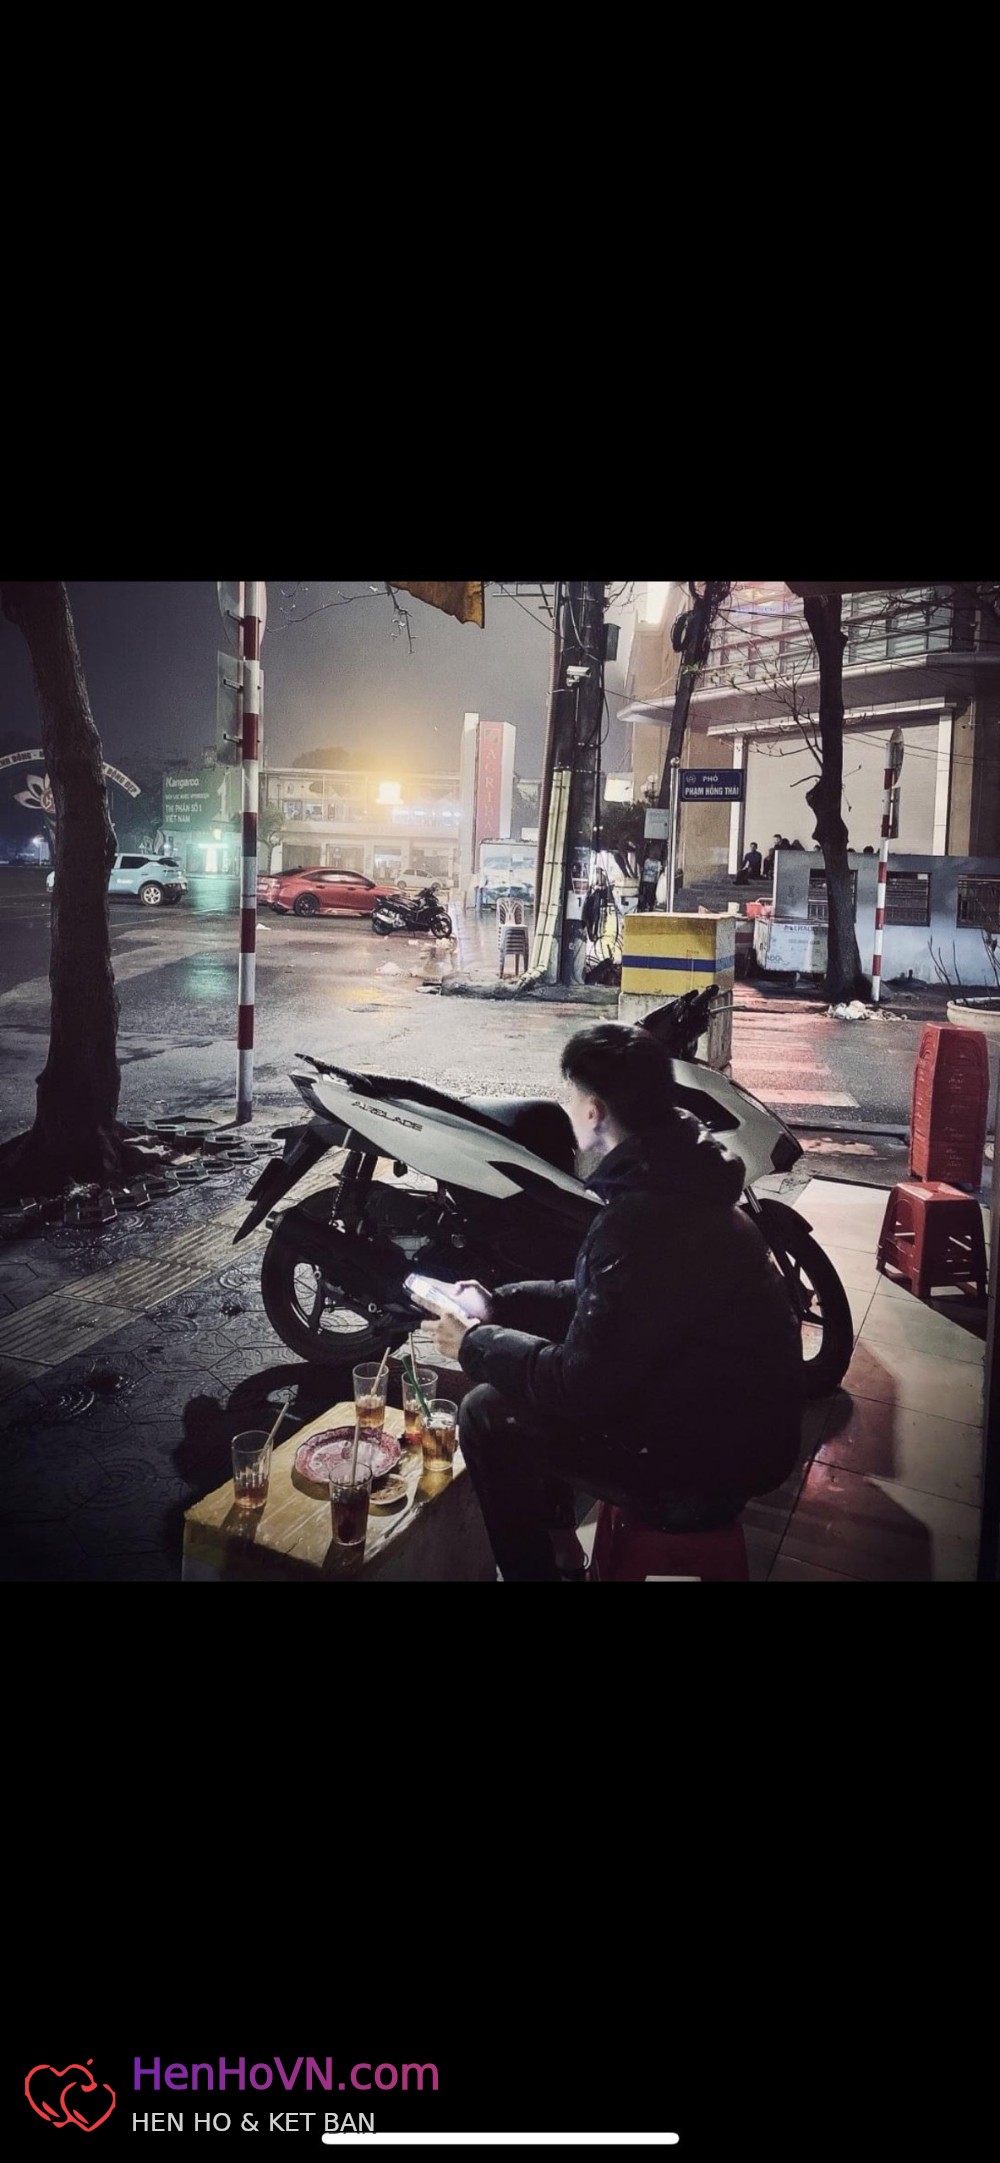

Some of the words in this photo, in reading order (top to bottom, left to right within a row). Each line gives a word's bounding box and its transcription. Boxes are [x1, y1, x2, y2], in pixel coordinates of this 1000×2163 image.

[165, 777, 199, 789] Kangaroo
[685, 787, 704, 798] PHẠM
[724, 785, 740, 795] THÁI
[177, 814, 191, 823] NAM
